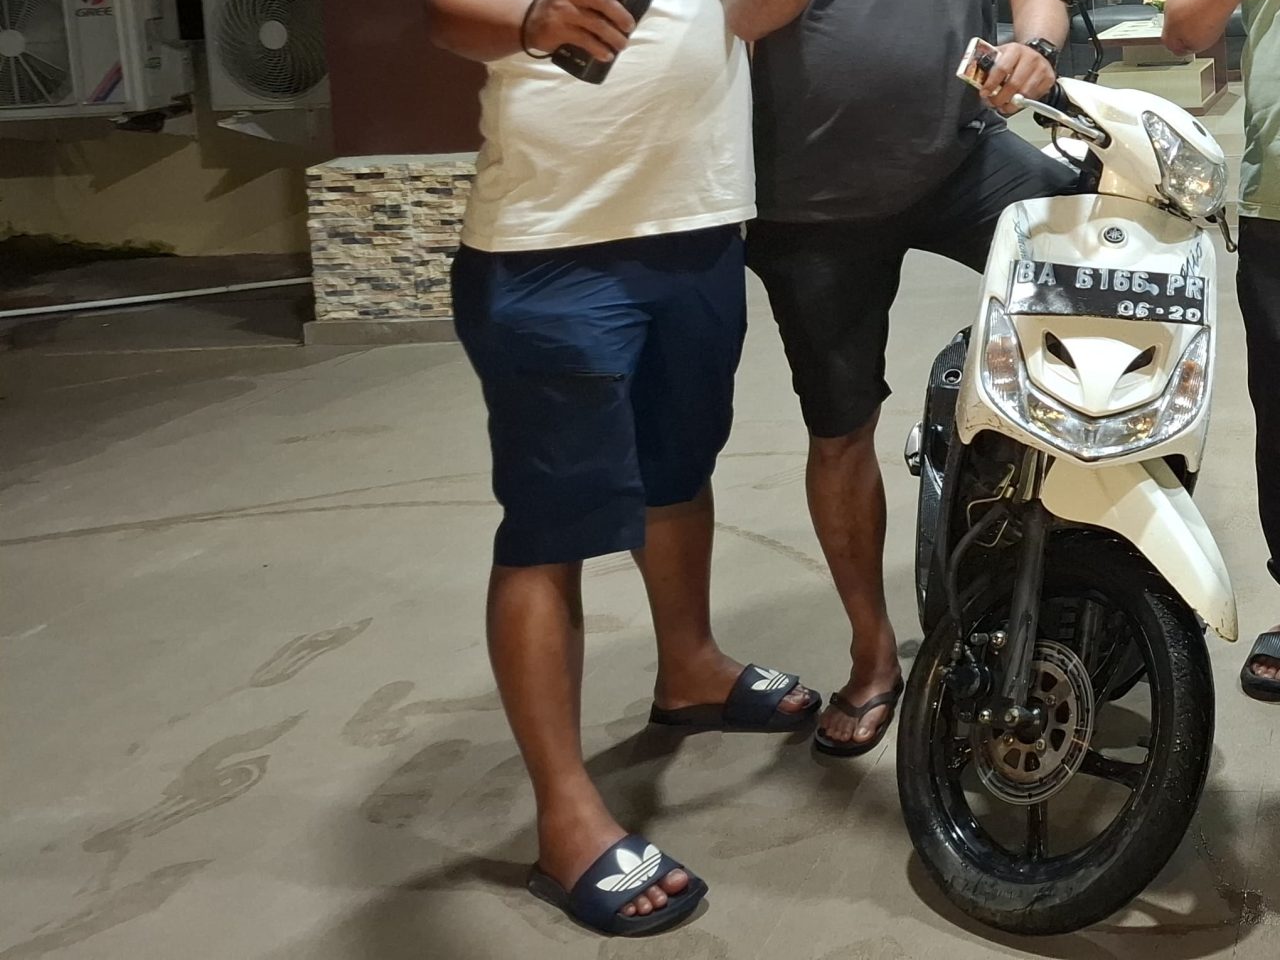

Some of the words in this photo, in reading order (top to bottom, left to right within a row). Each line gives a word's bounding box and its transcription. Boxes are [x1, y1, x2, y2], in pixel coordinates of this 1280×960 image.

[75, 7, 112, 18] GREE
[1017, 260, 1057, 286] BA
[1166, 273, 1203, 300] PR
